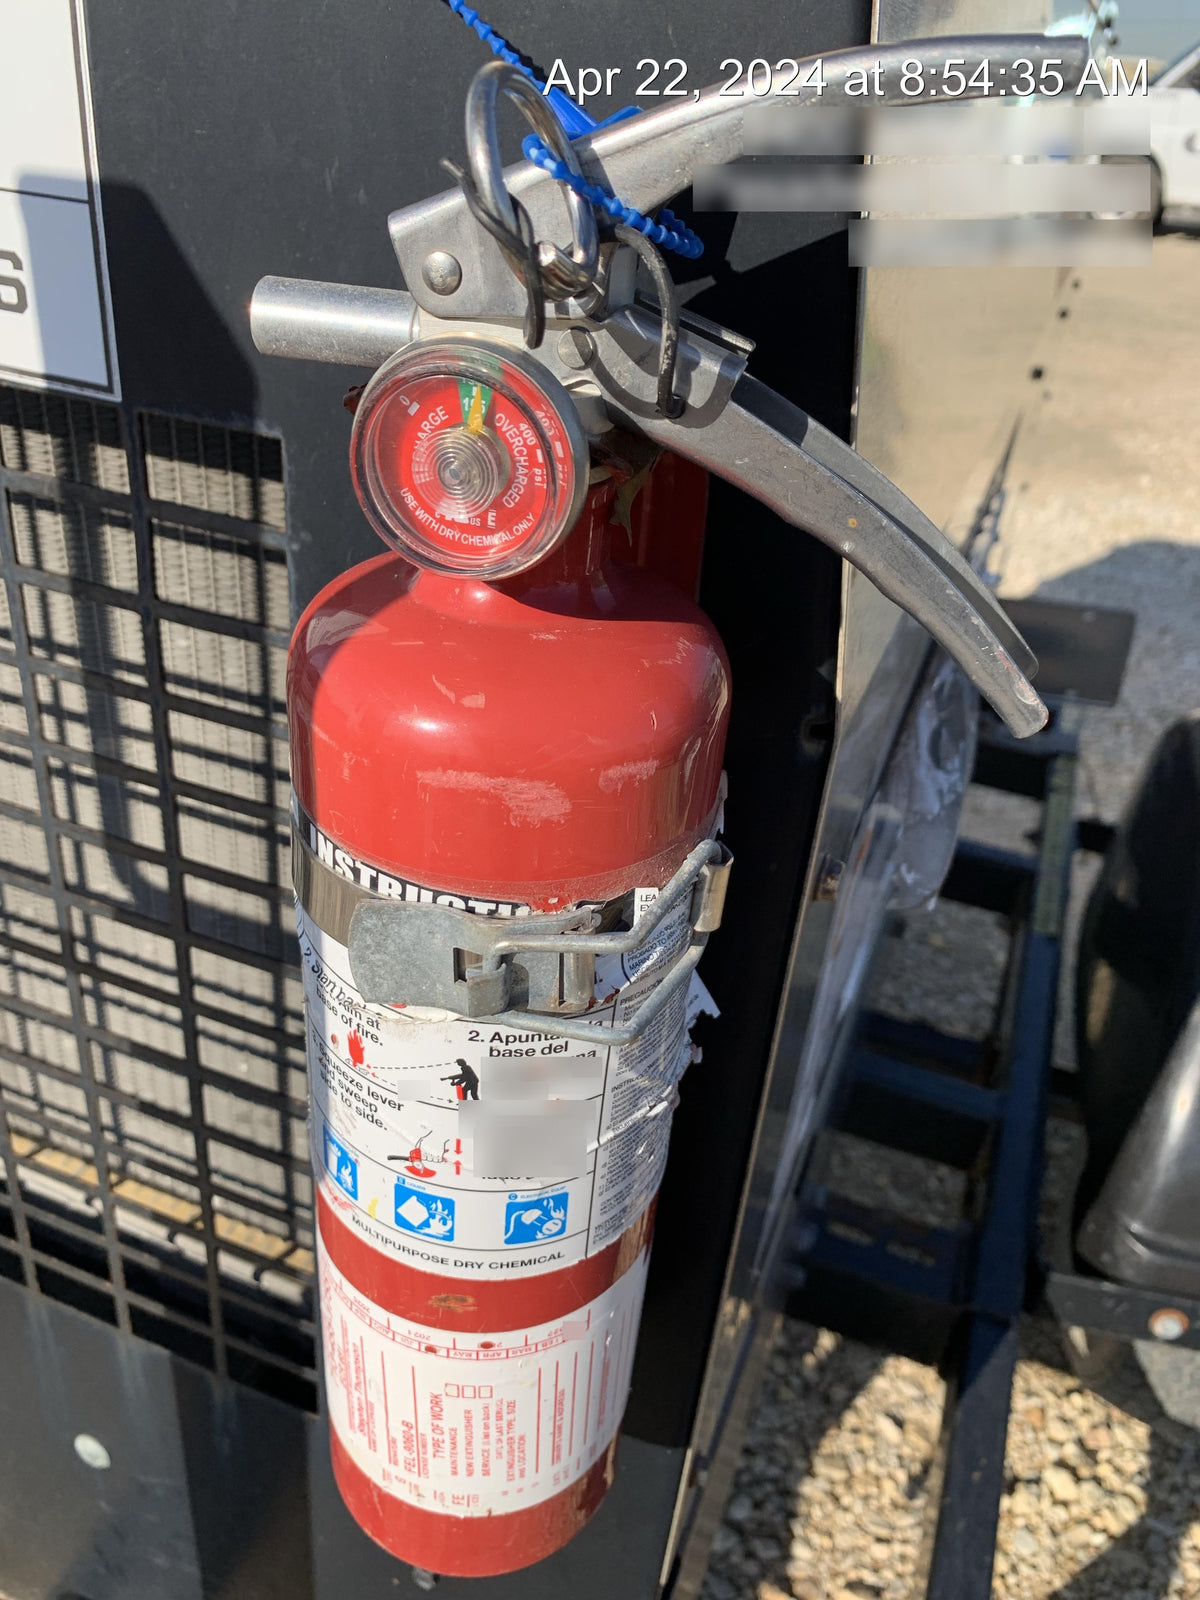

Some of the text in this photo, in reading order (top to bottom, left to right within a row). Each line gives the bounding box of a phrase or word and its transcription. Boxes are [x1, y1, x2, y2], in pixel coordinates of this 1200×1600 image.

[463, 397, 486, 413] 15
[519, 422, 537, 446] 400
[494, 412, 530, 508] OVERCHARGED
[400, 487, 536, 547] USE WITH DRY CHEMICAL ONLY
[341, 1014, 353, 1028] of
[356, 1022, 384, 1047] fire.
[366, 1016, 381, 1031] at
[467, 1030, 485, 1043] 2.
[489, 1046, 537, 1058] base
[541, 1041, 569, 1055] del
[338, 1079, 379, 1114] sweep
[340, 1092, 353, 1108] to
[355, 1105, 388, 1131] side.
[367, 1085, 405, 1112] lever
[351, 1213, 566, 1270] MULTIPURPOSE DRY CHEMICAL
[506, 1400, 516, 1415] SIZE
[430, 1392, 446, 1458] TYPE OF WORK
[449, 1427, 459, 1476] MAINTENANCE
[464, 1409, 475, 1476] NEW EXTINGUISHER
[506, 1436, 516, 1481] EXTINGUISHER
[481, 1448, 491, 1476] SERVICE
